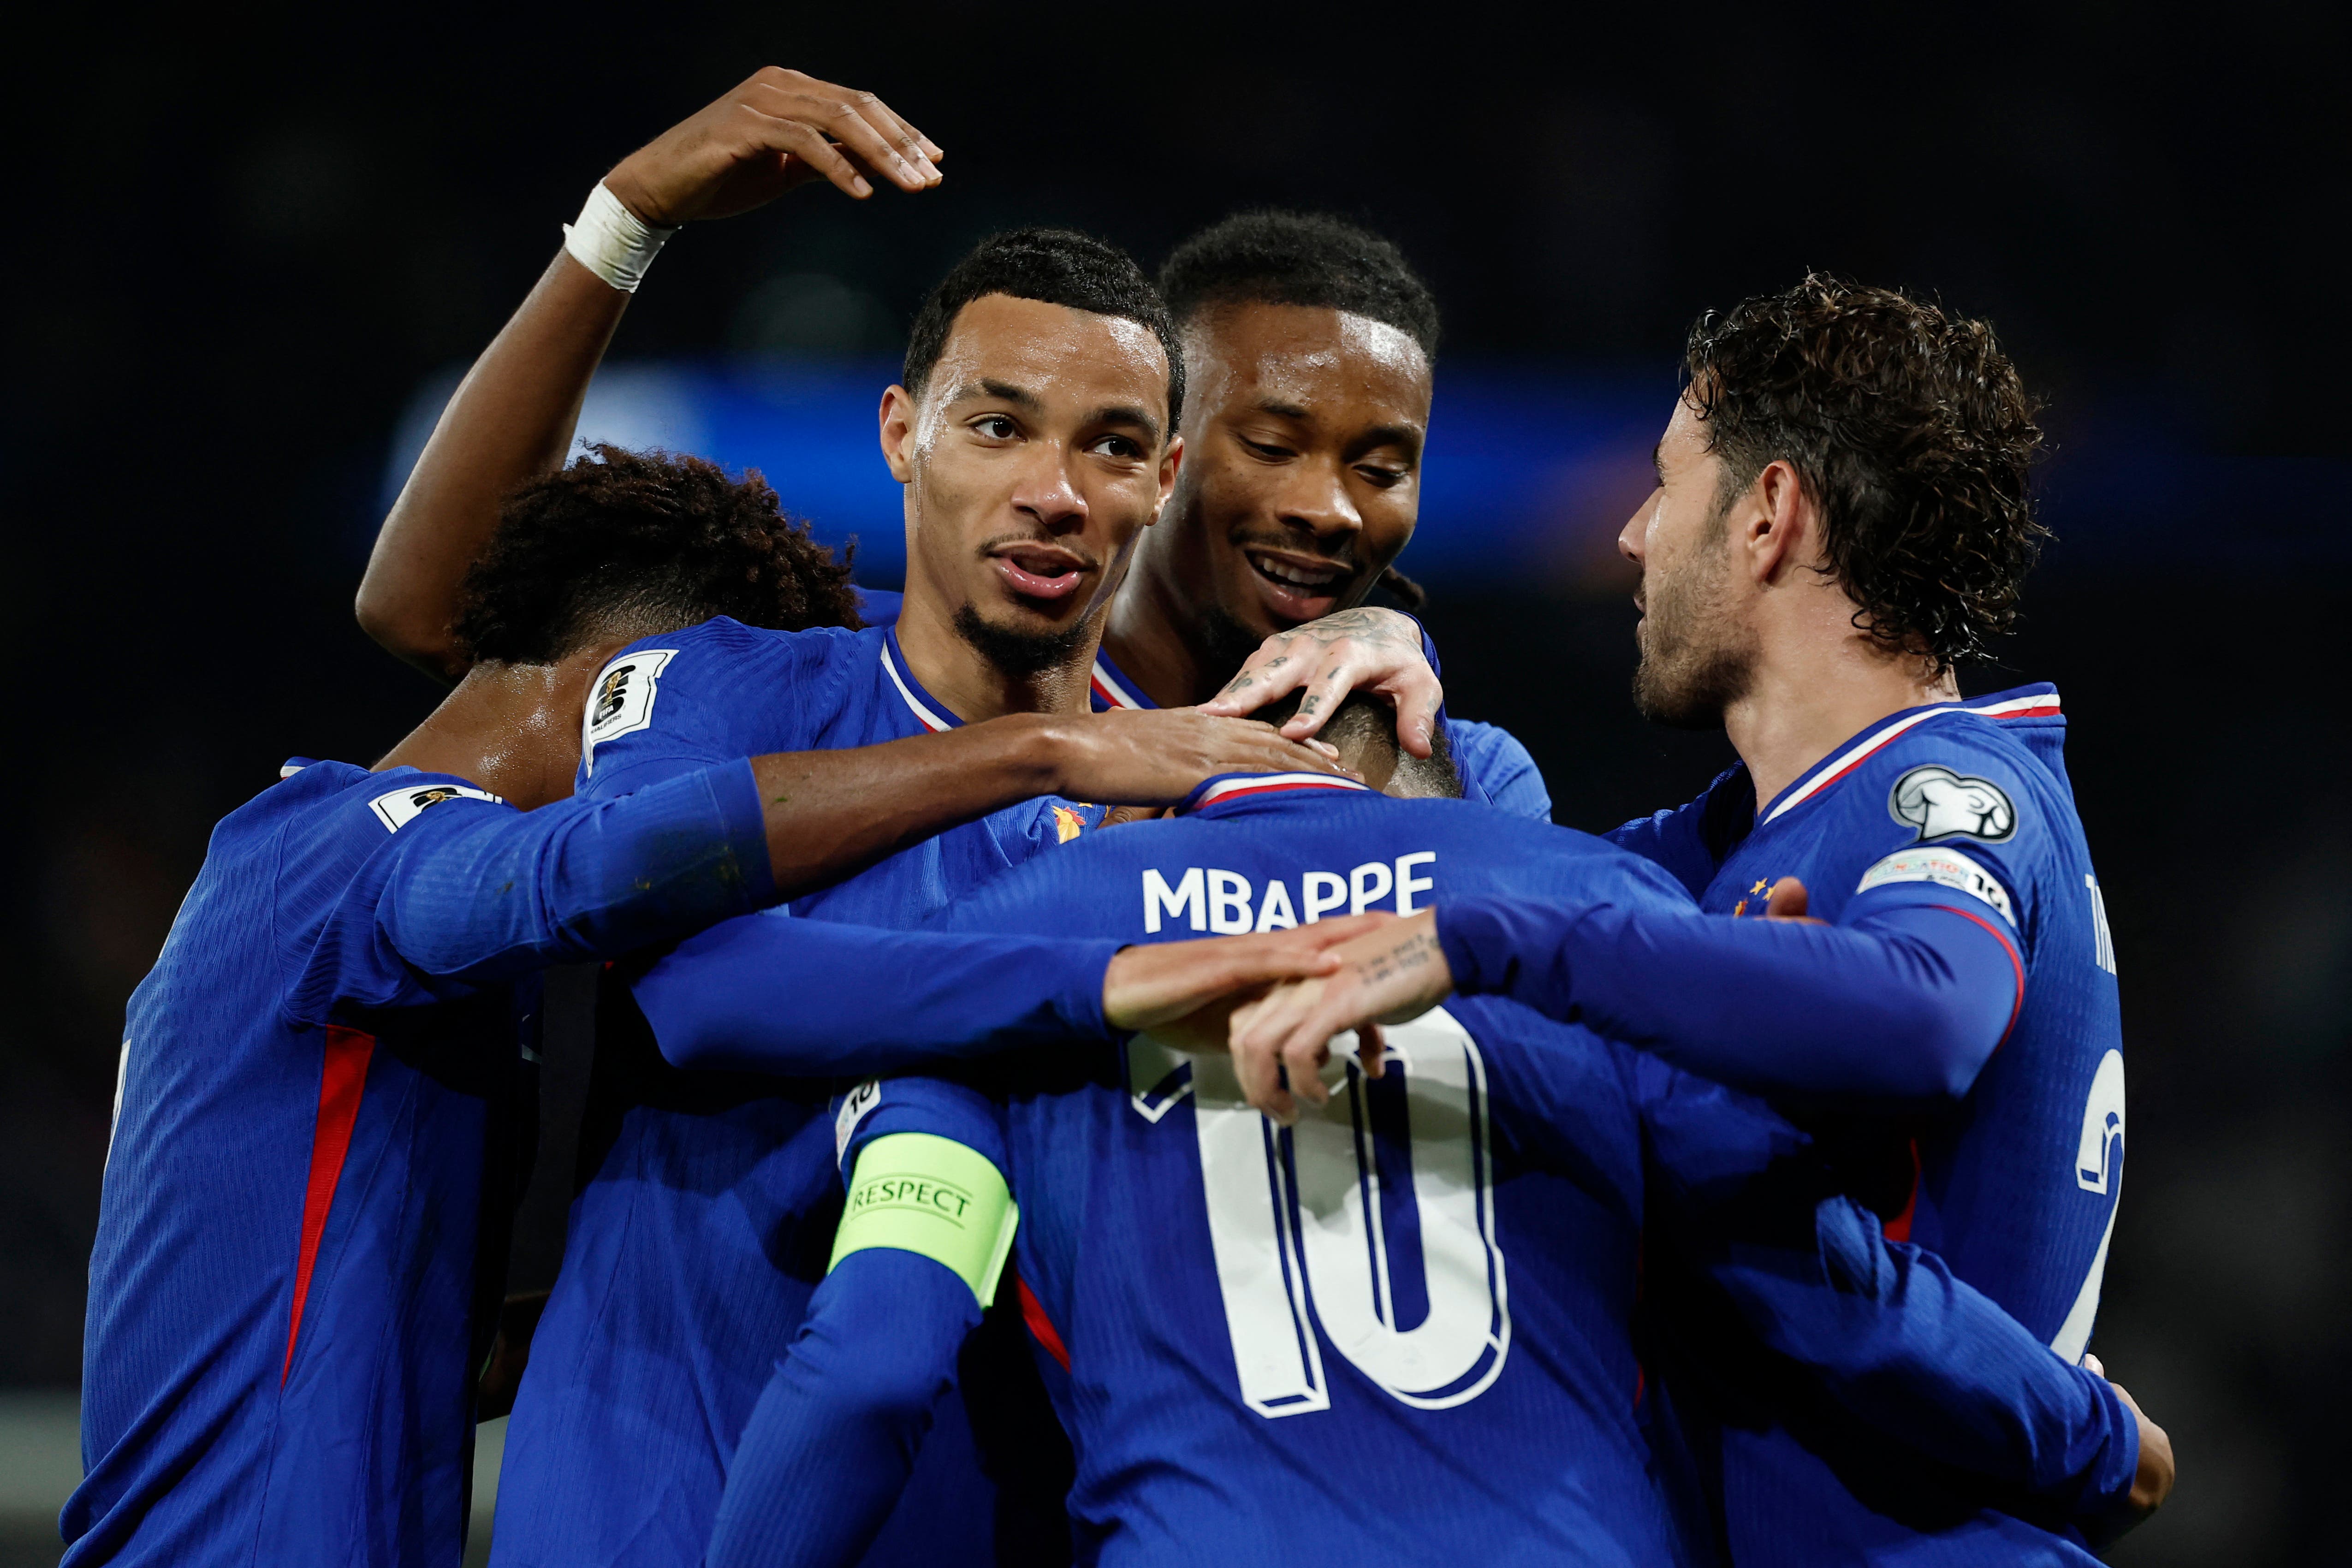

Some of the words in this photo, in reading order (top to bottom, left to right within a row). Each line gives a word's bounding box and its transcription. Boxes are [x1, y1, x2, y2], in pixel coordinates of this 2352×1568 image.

[590, 713, 622, 734] UALIFIERS
[599, 705, 614, 721] FIFA
[1142, 851, 1437, 935] MBAPPE
[851, 1082, 873, 1115] 10
[853, 1181, 971, 1218] RESPECT
[1128, 1005, 1512, 1419] 10
